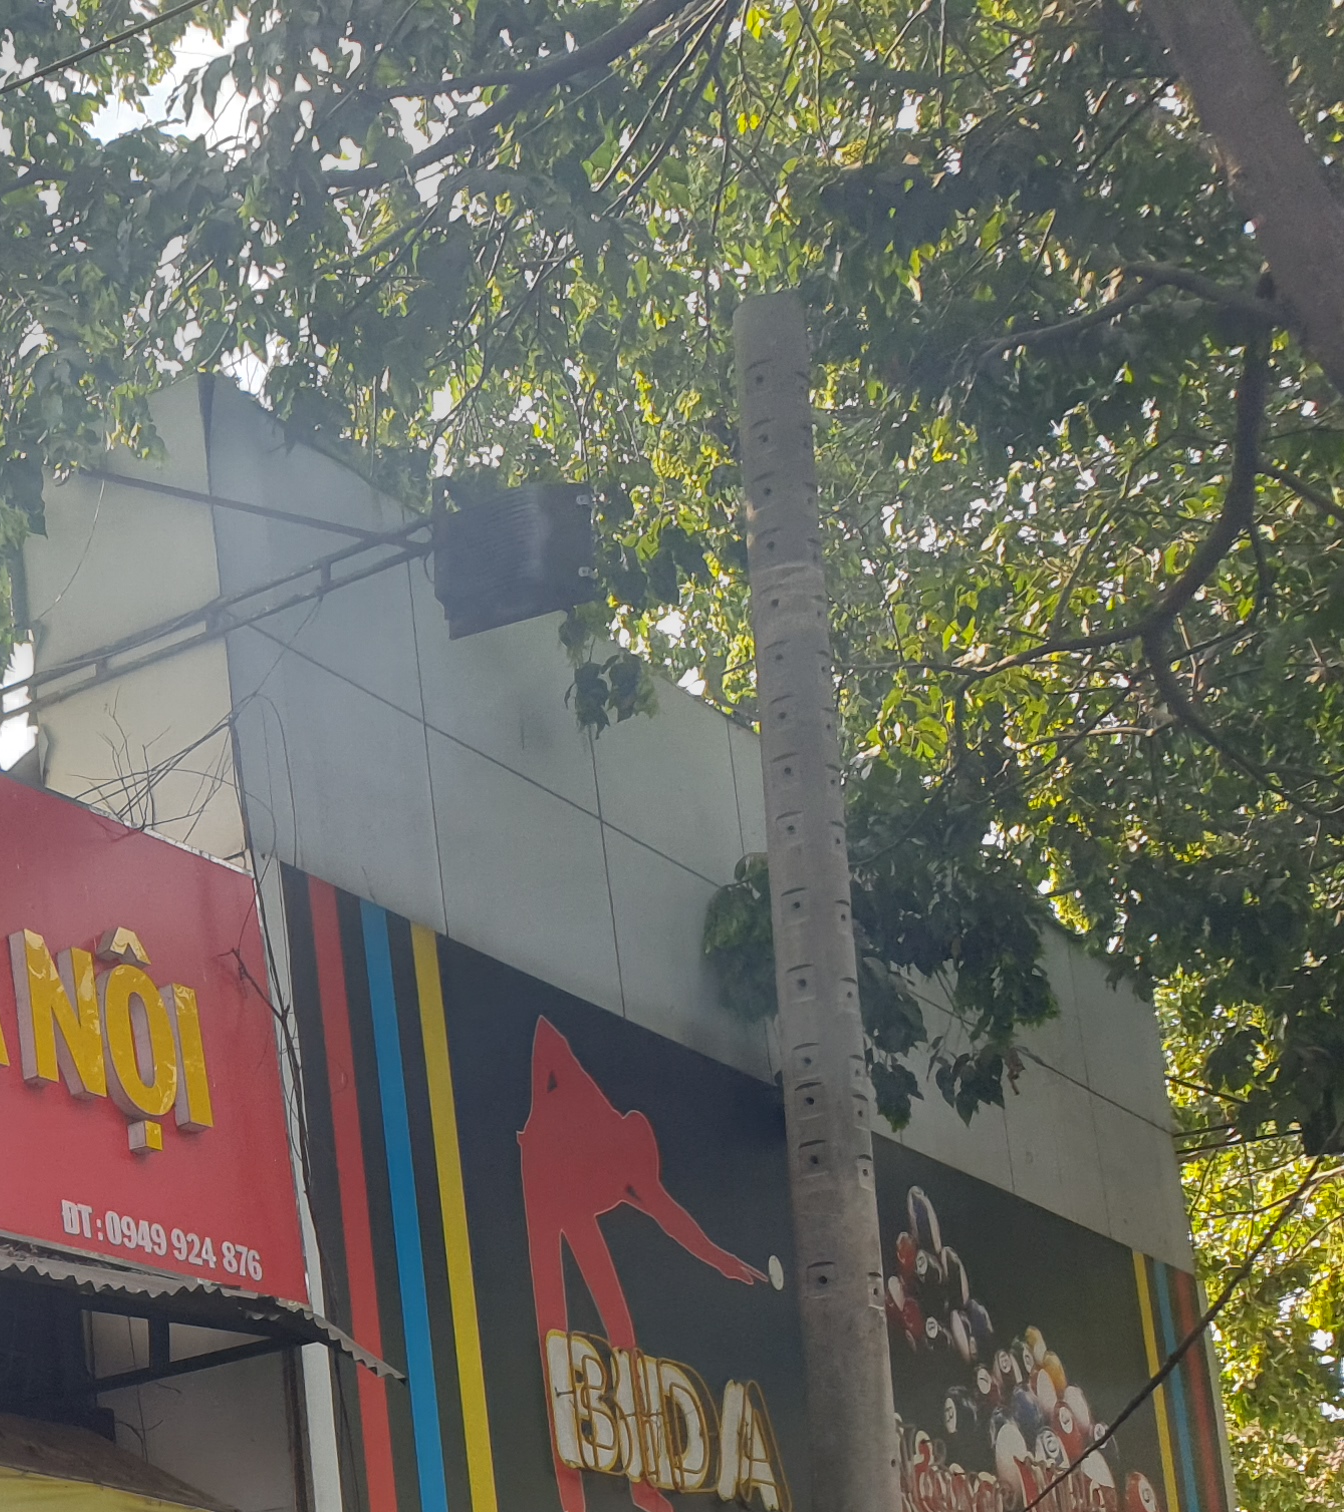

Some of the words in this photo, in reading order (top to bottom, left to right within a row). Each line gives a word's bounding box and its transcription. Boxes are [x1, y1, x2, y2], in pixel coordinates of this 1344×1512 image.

[10, 928, 214, 1154] NỘI
[170, 1228, 217, 1269] 924
[221, 1241, 263, 1281] 876
